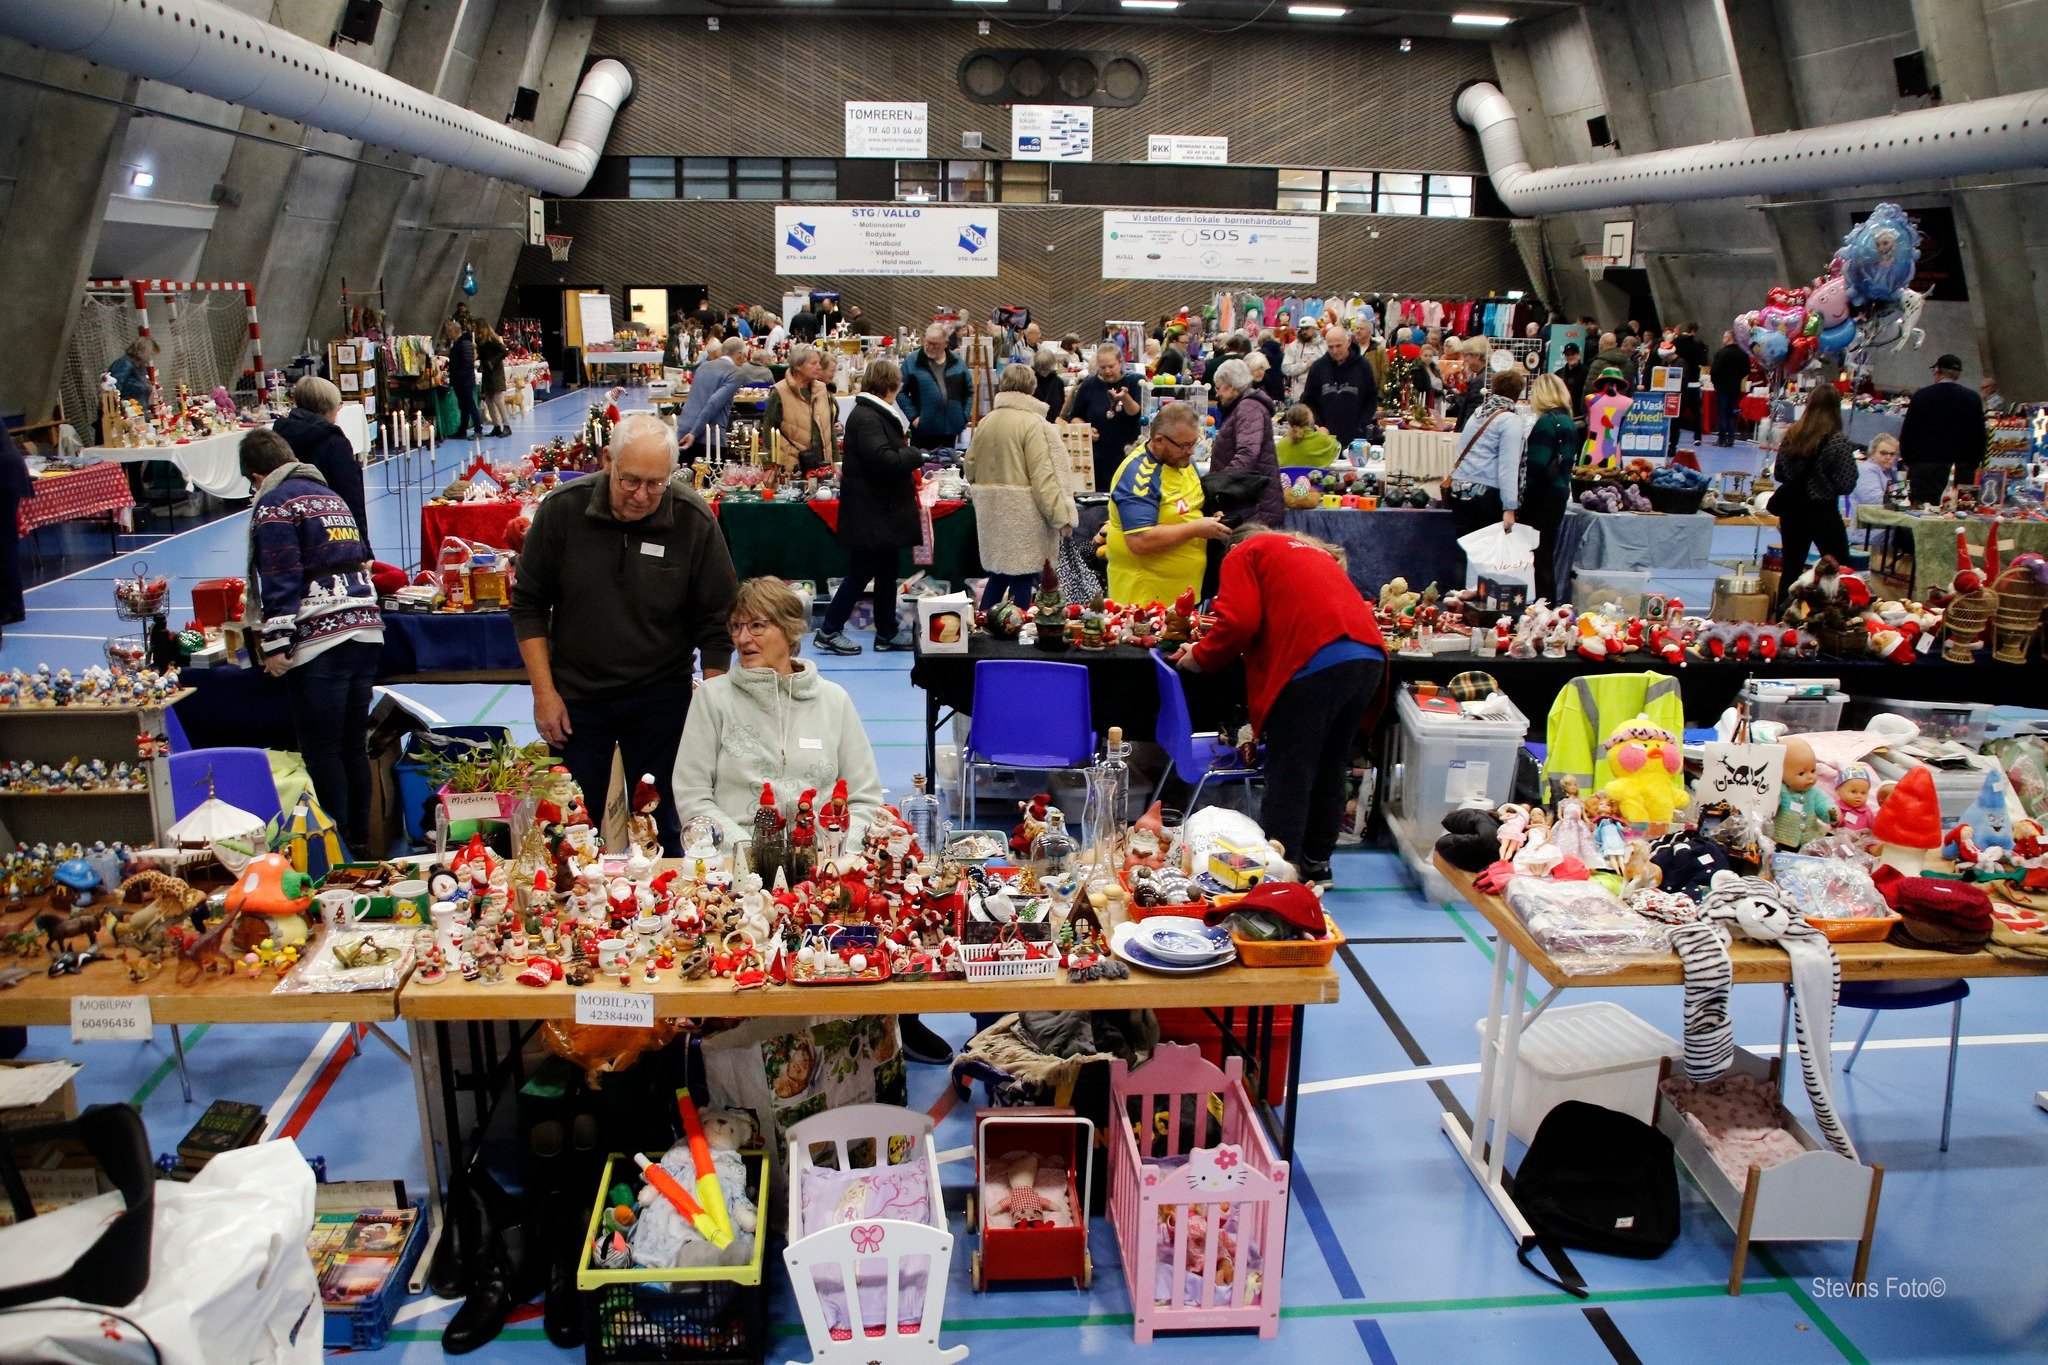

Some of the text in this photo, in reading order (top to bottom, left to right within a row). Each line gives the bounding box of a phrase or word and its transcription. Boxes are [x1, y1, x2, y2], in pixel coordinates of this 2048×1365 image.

[848, 109, 912, 120] TØMREREN
[868, 126, 879, 134] Tlf.
[881, 126, 890, 134] 40
[1152, 144, 1170, 152] RKK
[852, 208, 875, 217] STG
[882, 209, 921, 218] VALLØ
[1132, 213, 1141, 221] Vi
[1144, 214, 1172, 222] støtter
[1194, 216, 1220, 224] lokale
[1224, 216, 1292, 226] børnehåndbold
[793, 226, 811, 243] STG
[965, 228, 982, 245] STG
[1200, 229, 1239, 241] SOS
[326, 527, 361, 542] XMAS
[80, 1000, 133, 1010] MOBILPAY
[580, 995, 650, 1010] MOBILPAY
[589, 1010, 643, 1023] 42384490
[81, 1018, 136, 1029] 60496436
